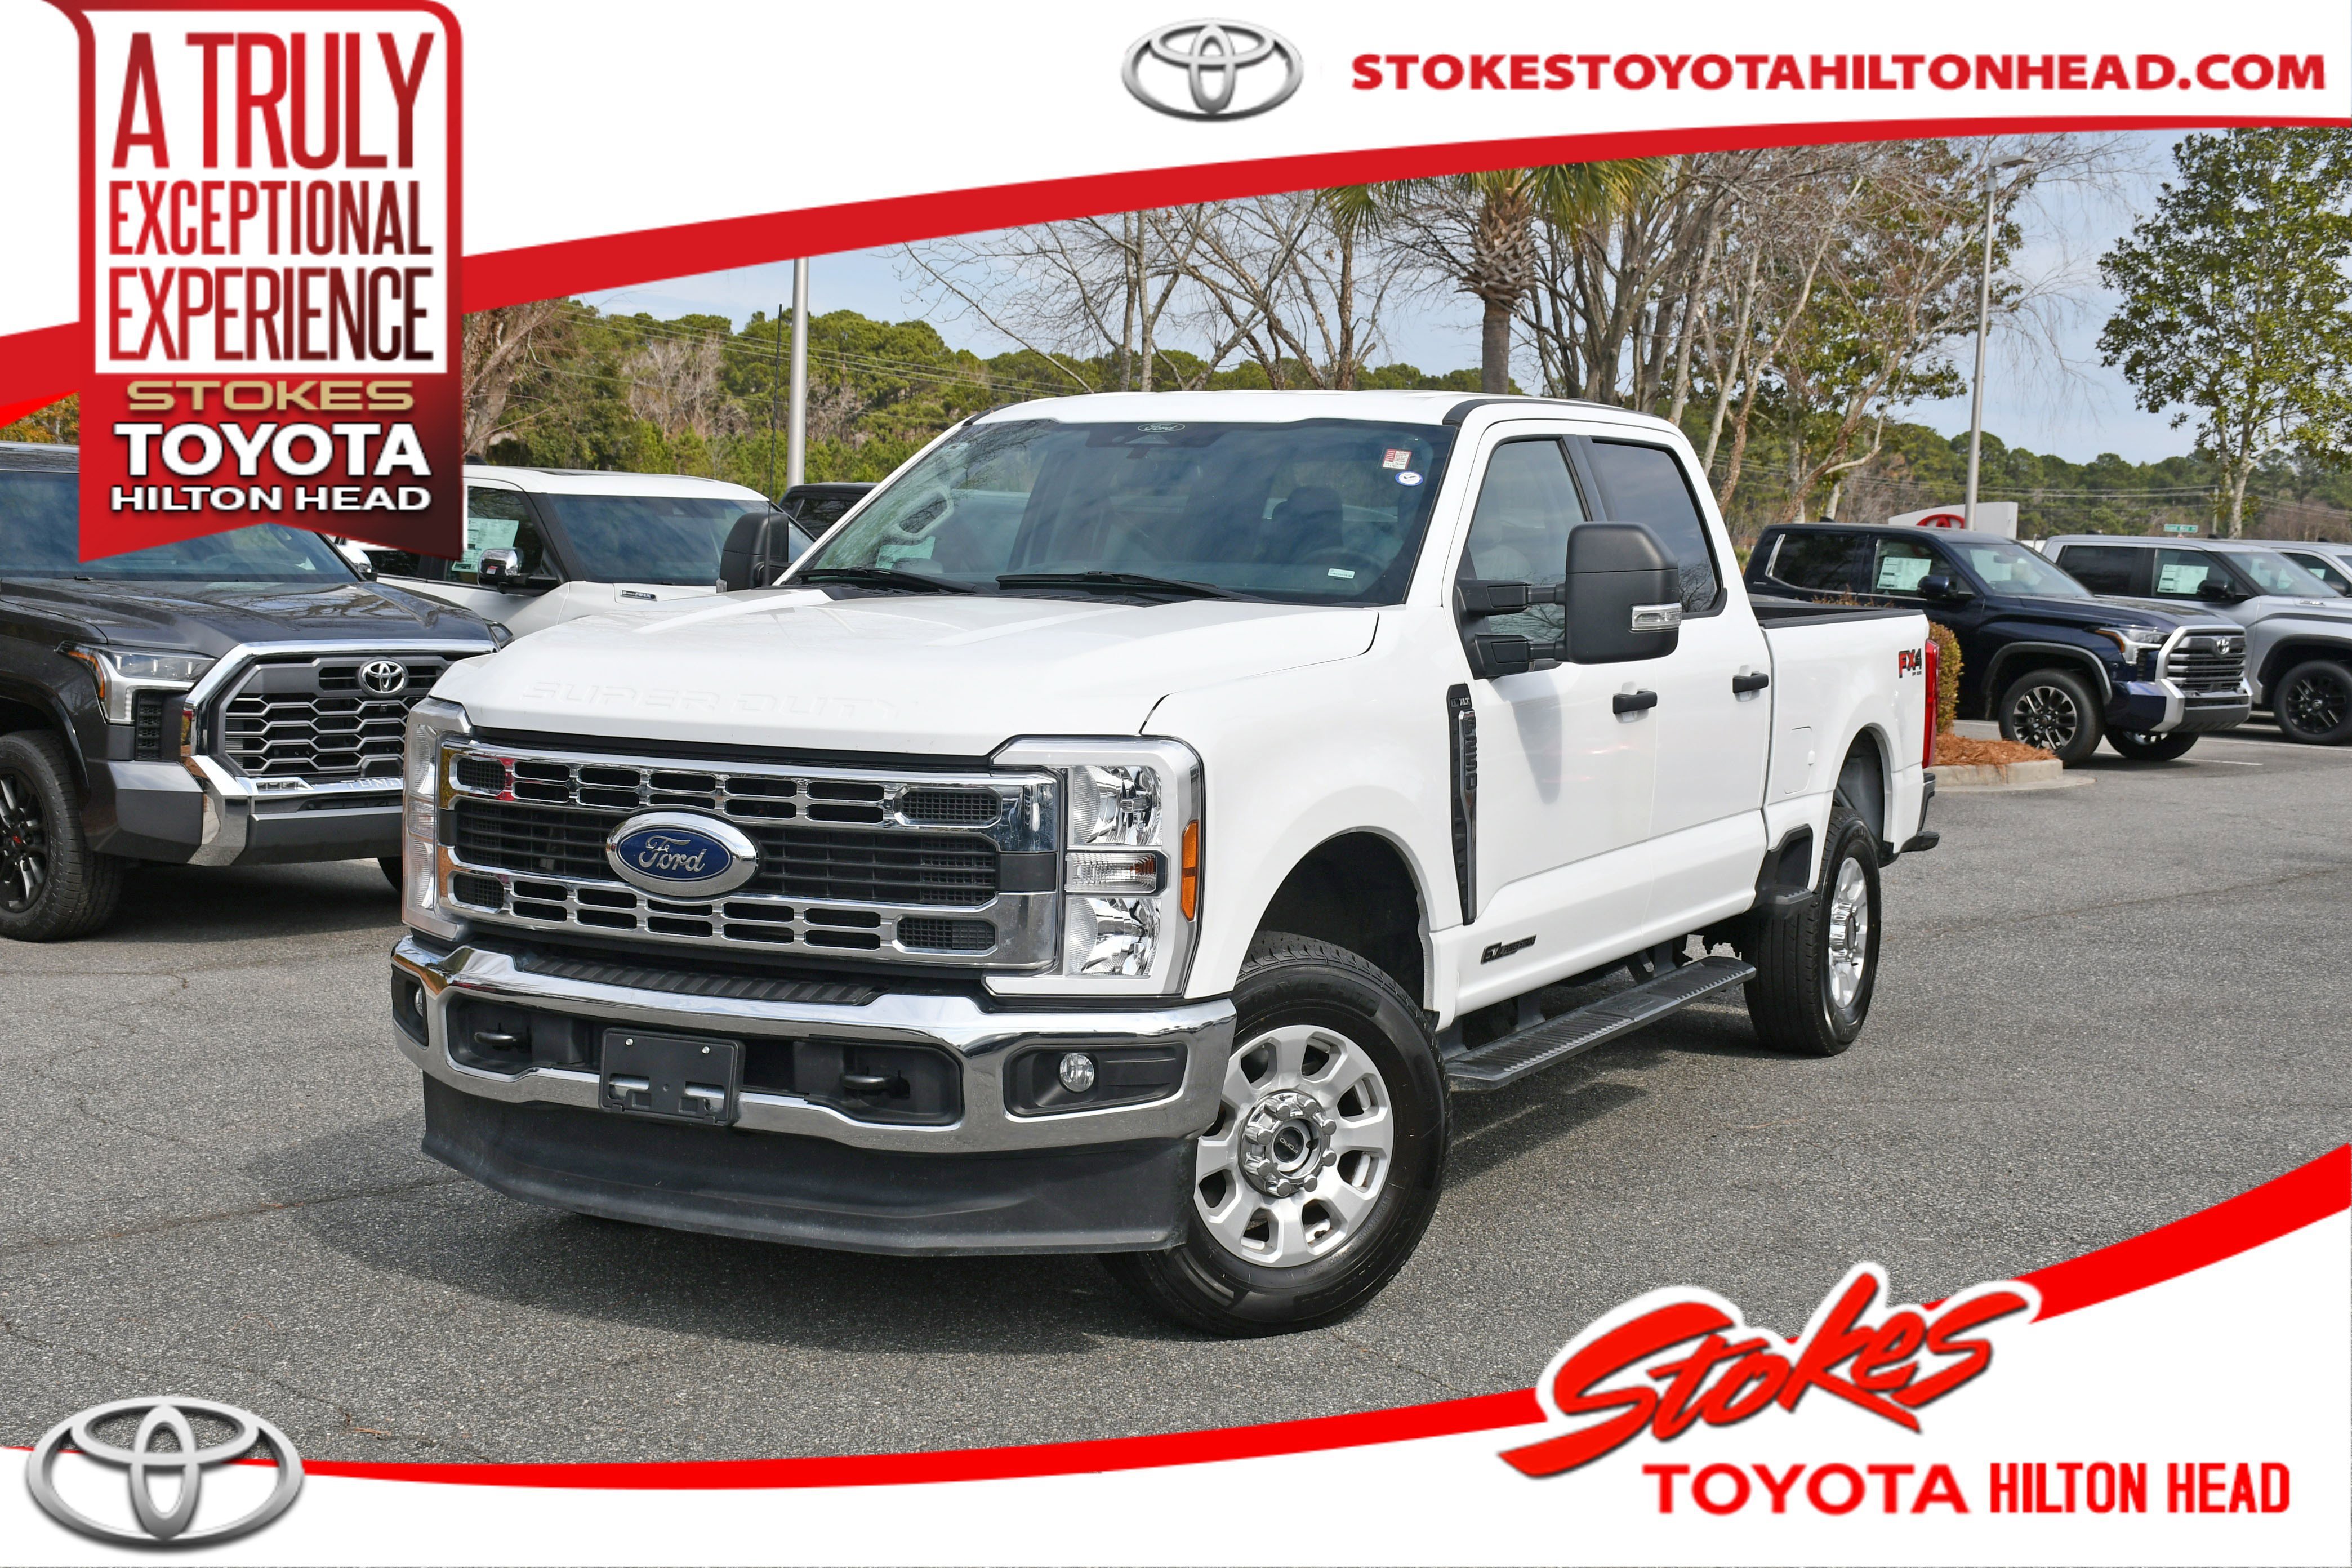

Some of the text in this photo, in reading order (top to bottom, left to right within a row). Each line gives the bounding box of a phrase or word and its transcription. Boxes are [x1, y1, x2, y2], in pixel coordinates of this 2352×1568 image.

[1899, 648, 1922, 678] FX4
[520, 680, 900, 721] SUPER DUTY
[1459, 696, 1470, 706] XLT
[341, 777, 404, 789] TUND
[638, 835, 706, 873] Ford
[1280, 1137, 1299, 1153] FORD
